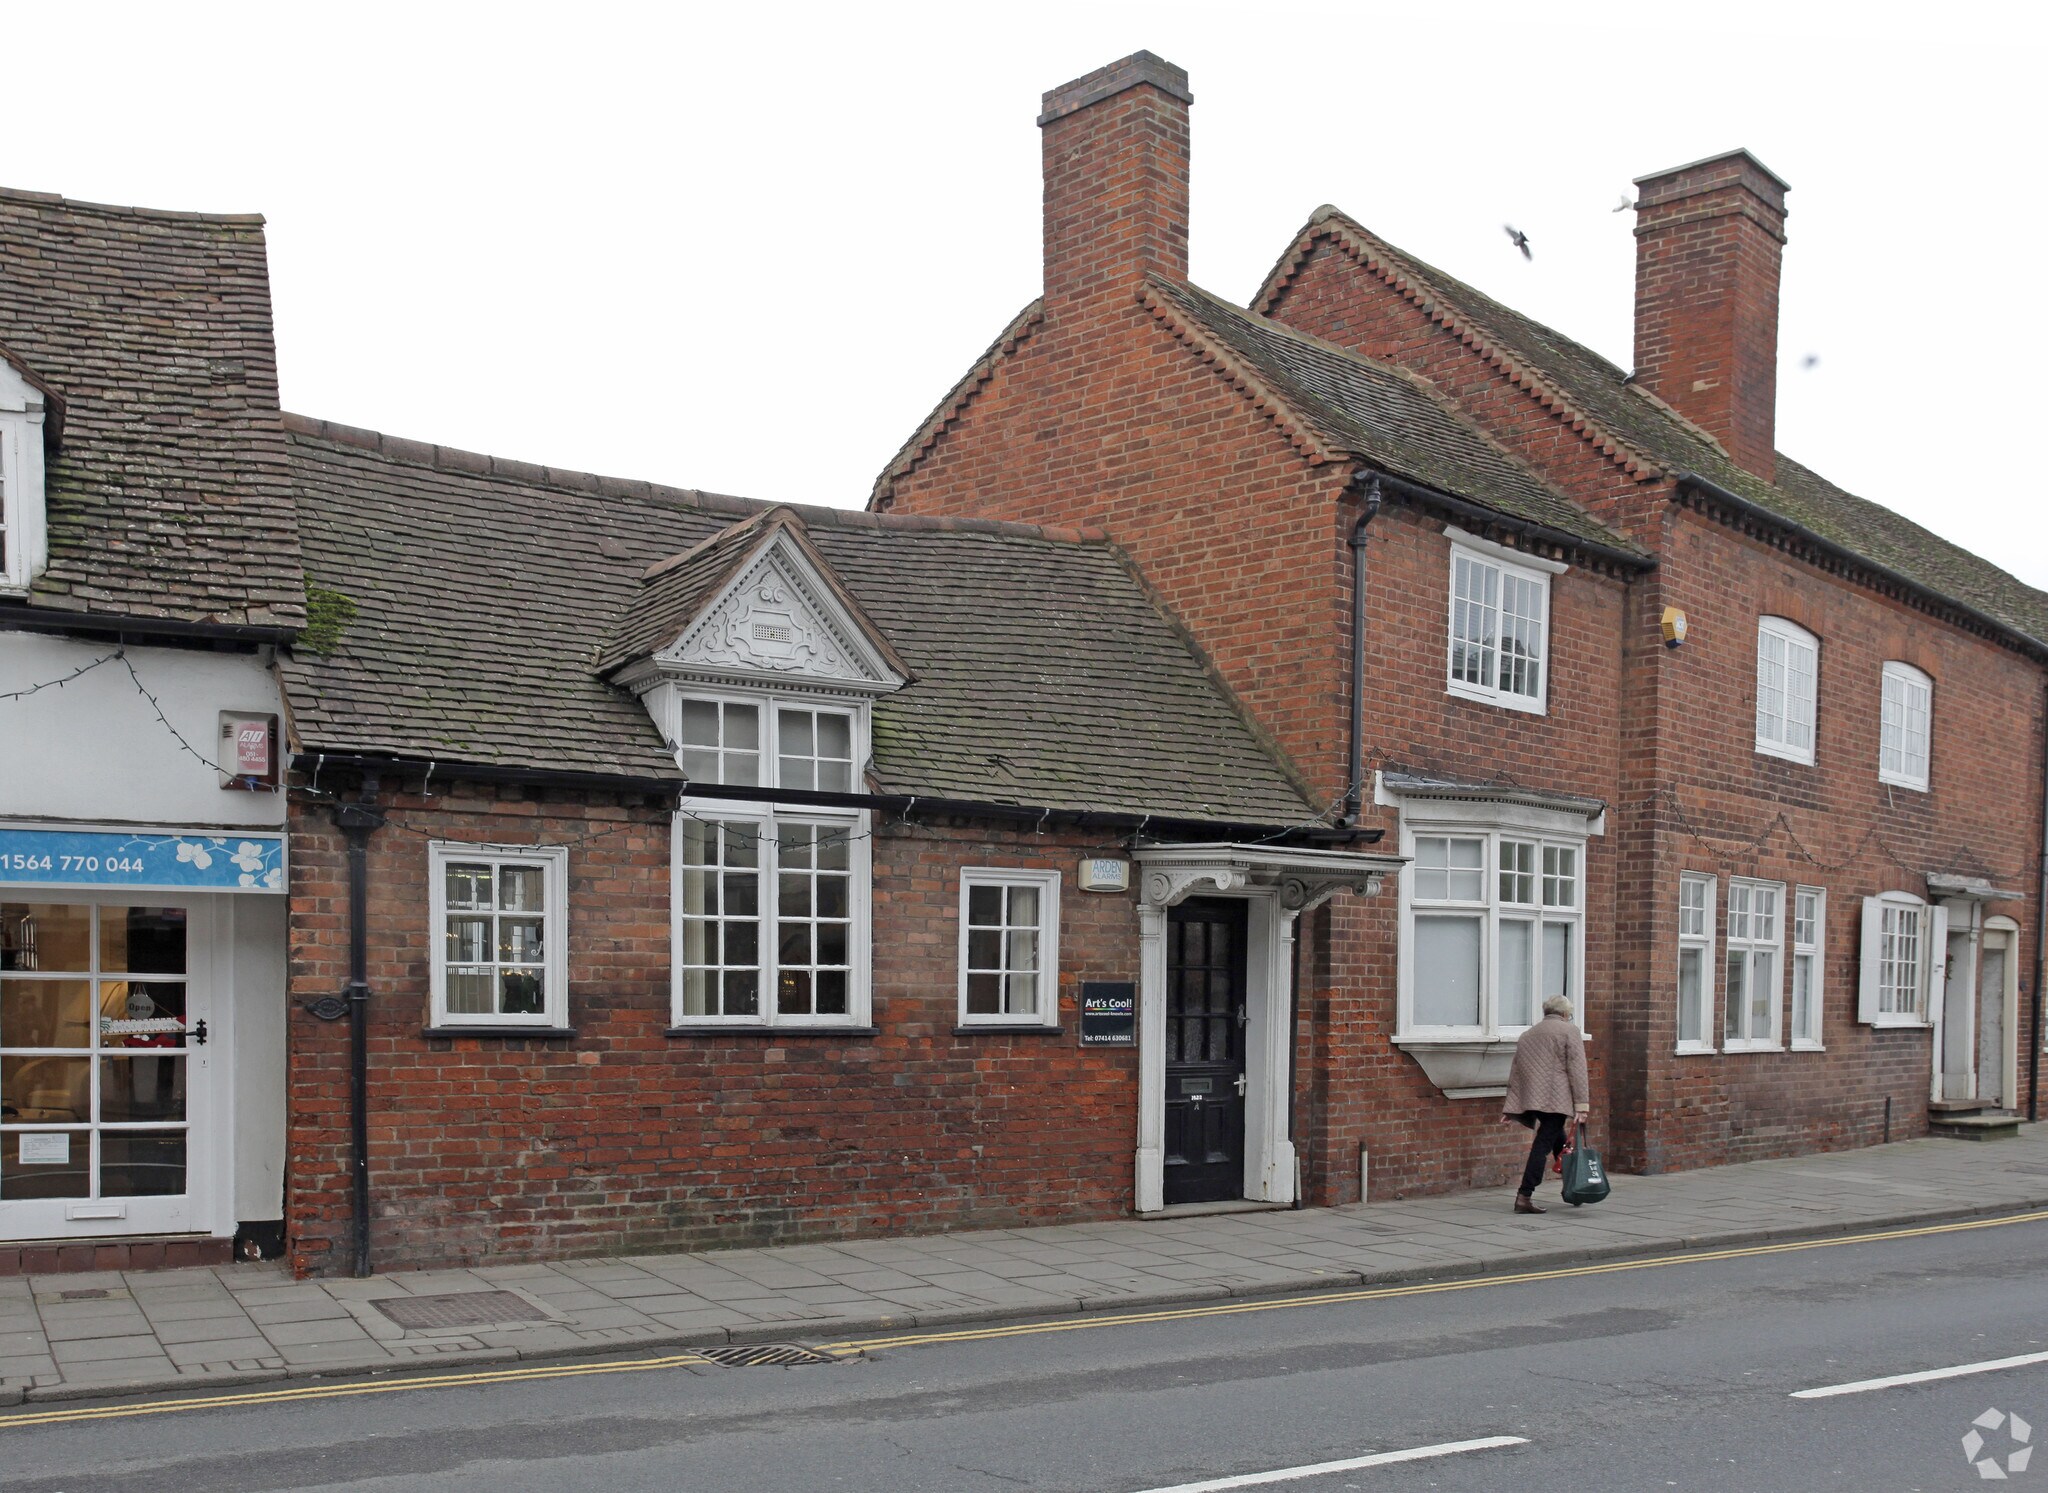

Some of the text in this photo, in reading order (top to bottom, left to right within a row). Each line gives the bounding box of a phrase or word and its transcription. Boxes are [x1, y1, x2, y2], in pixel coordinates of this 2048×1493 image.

[0, 854, 144, 872] 1564 770 044
[1093, 860, 1121, 873] ARDEN
[129, 1003, 151, 1012] Open
[1085, 998, 1132, 1008] Art's Cool!
